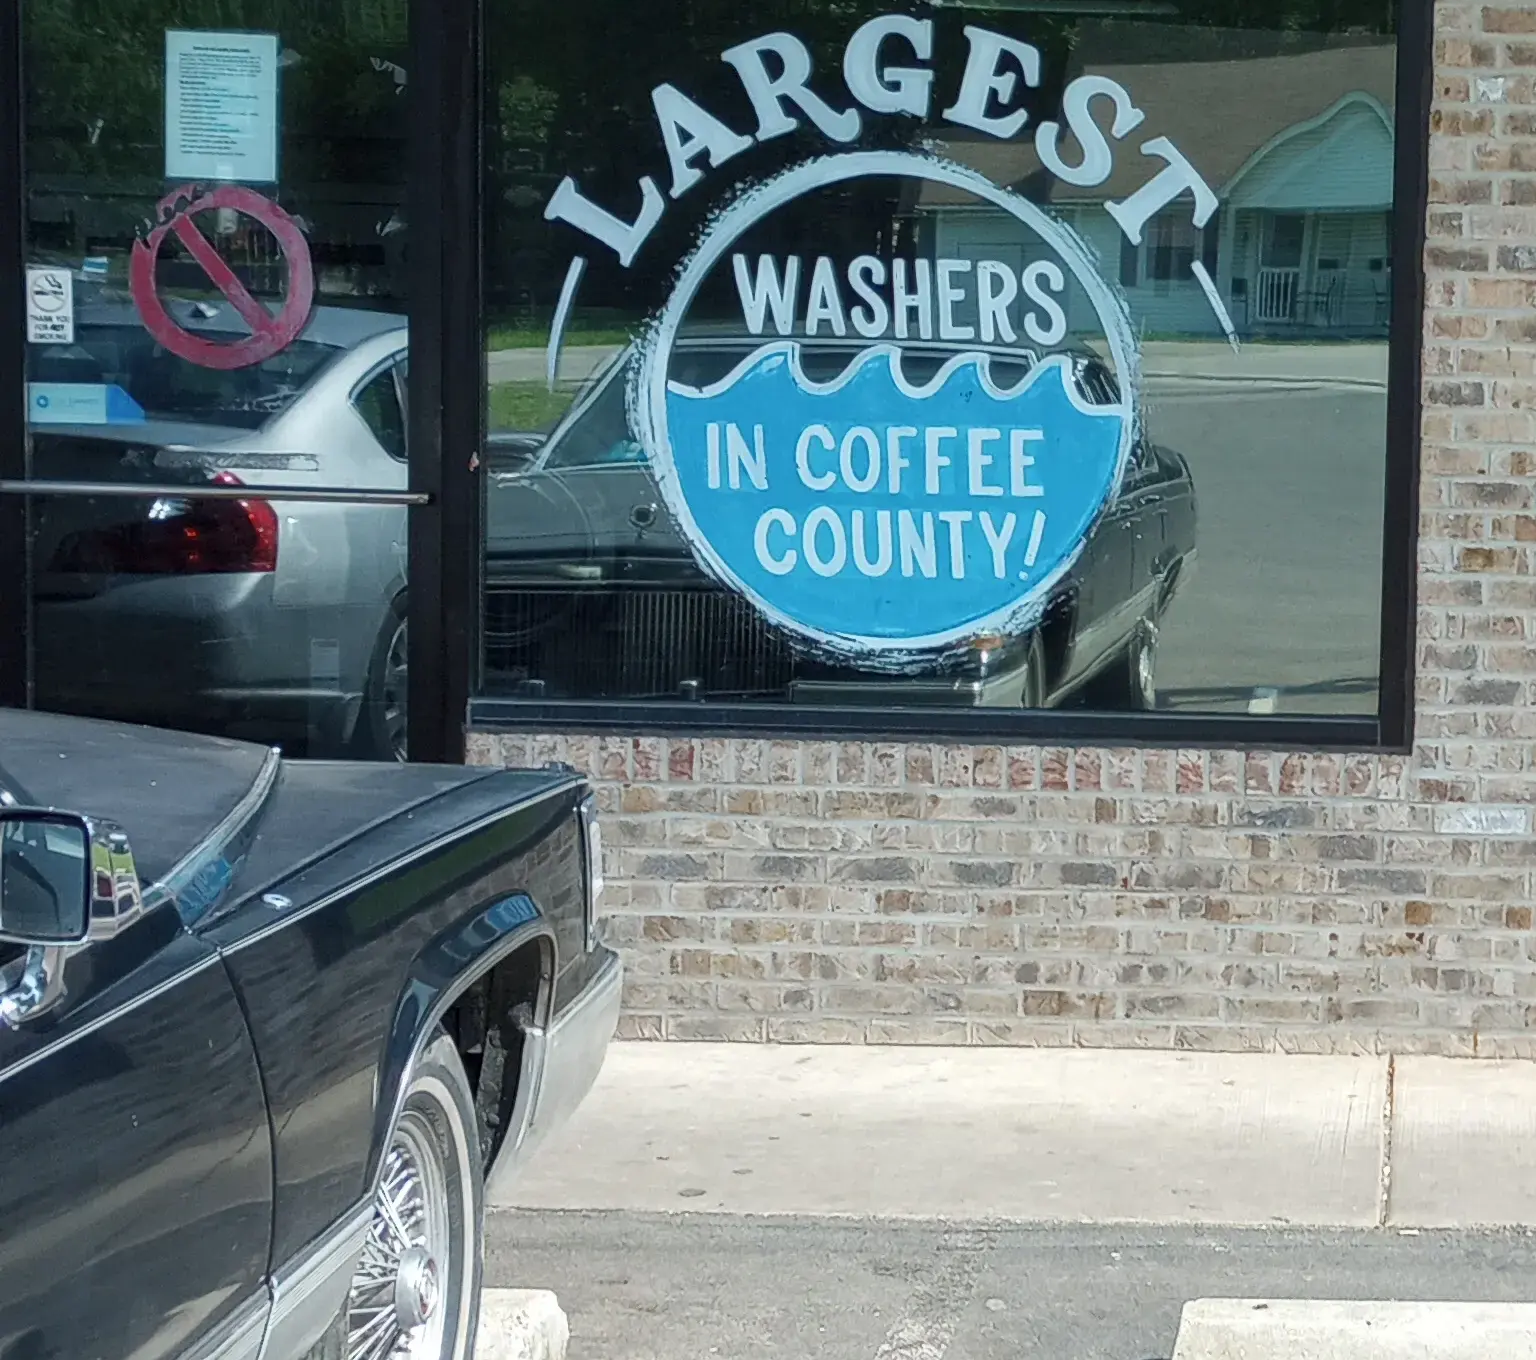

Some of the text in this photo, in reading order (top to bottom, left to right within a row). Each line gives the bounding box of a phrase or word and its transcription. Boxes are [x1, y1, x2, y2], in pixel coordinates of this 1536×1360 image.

[544, 13, 1219, 268] LARGEST
[733, 253, 1068, 346] WASHERS
[706, 423, 1045, 499] IN COFFEE
[753, 507, 1048, 583] COUNTY!
